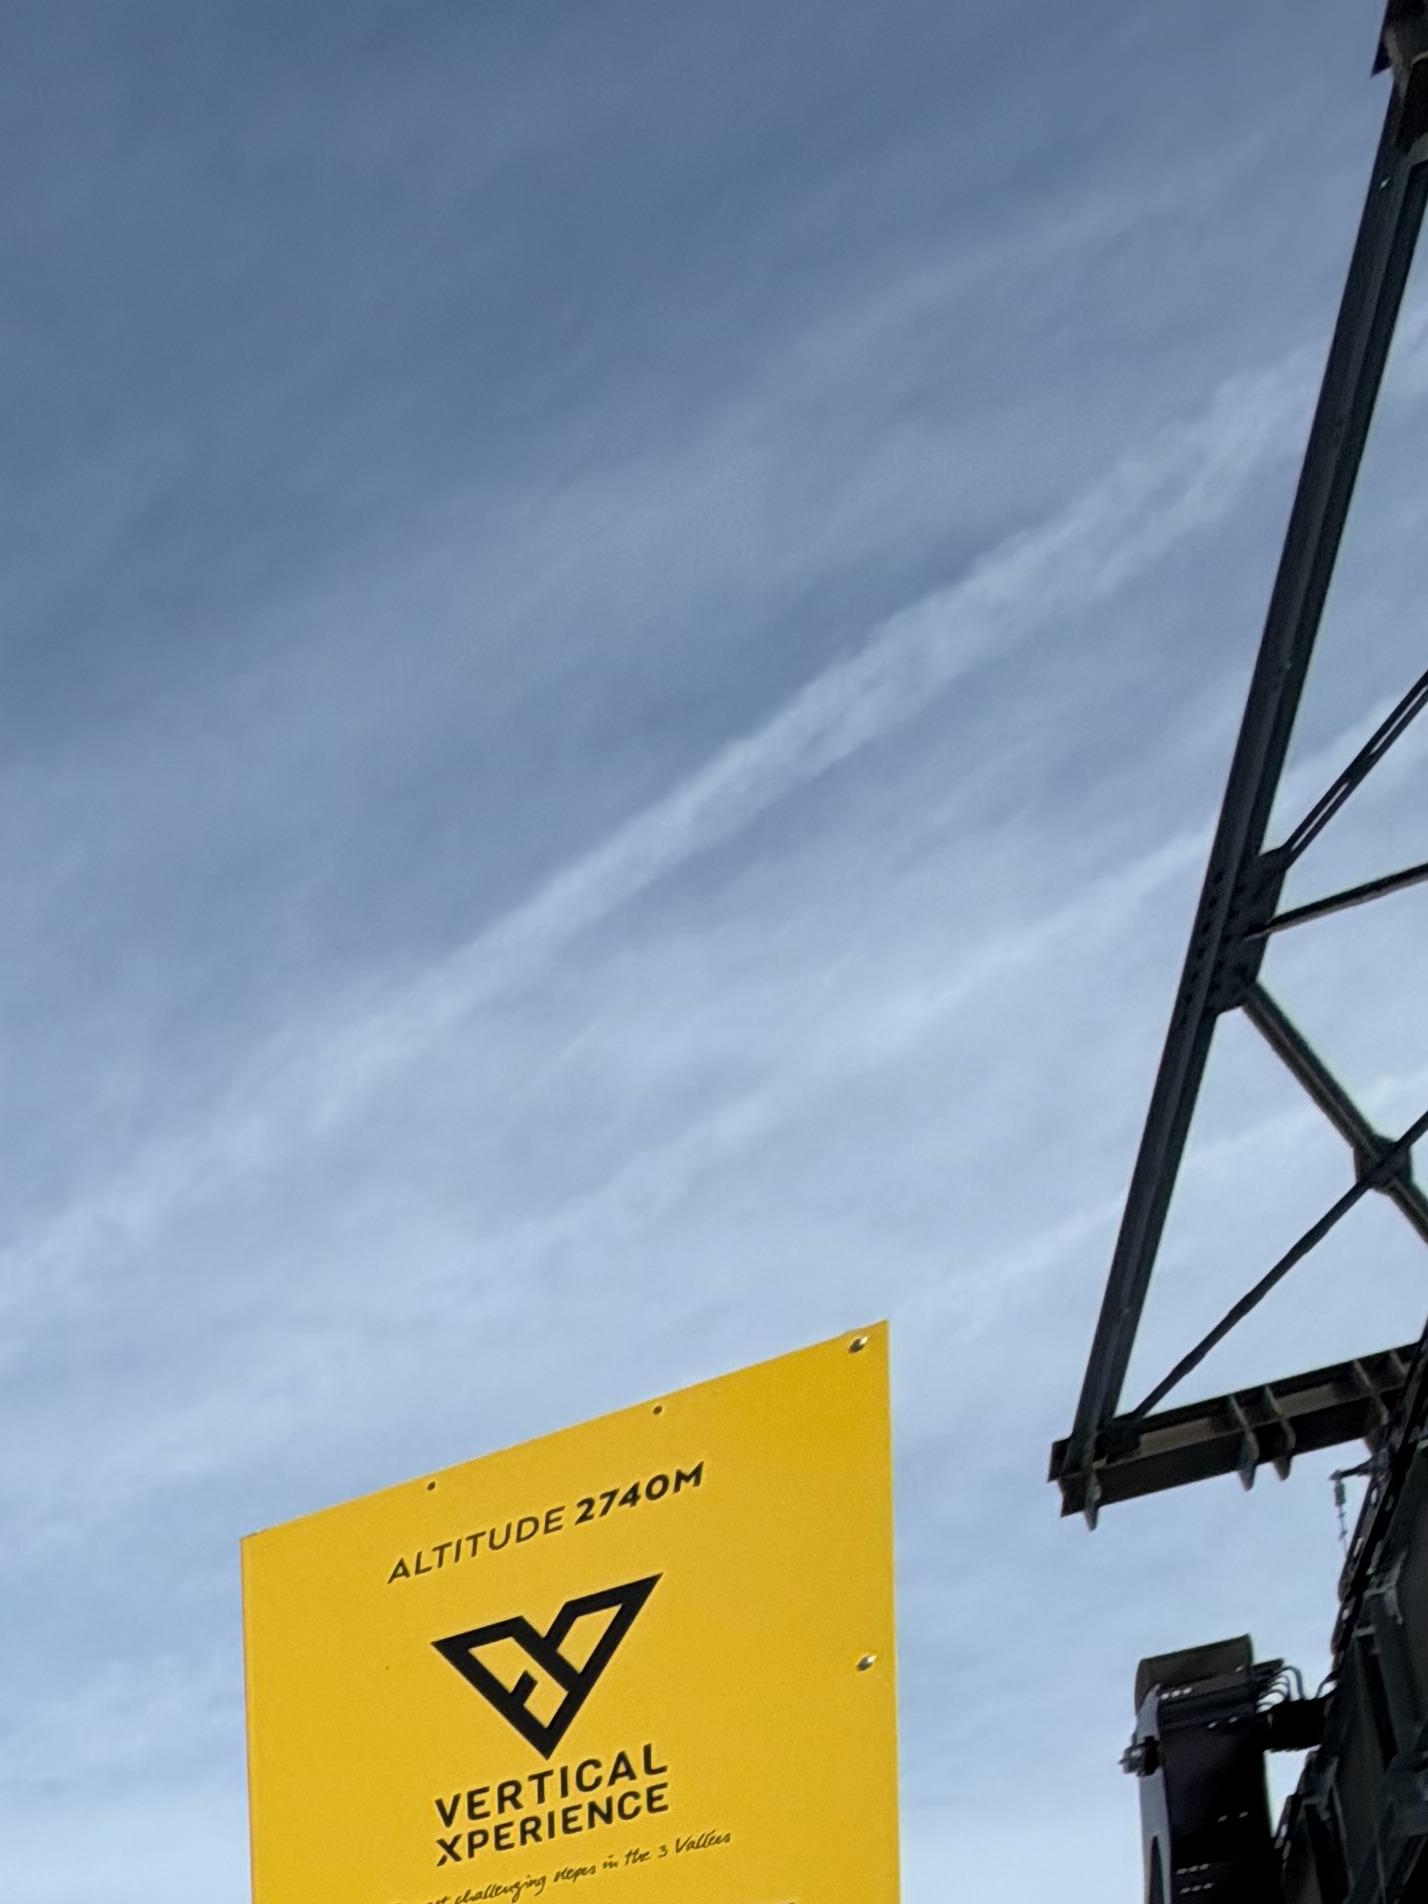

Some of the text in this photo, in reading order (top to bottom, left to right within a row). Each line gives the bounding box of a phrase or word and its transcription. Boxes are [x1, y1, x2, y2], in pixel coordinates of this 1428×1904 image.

[387, 1461, 704, 1584] ALTITUDE 2740M
[434, 1743, 668, 1828] VERTICAL
[436, 1782, 669, 1867] XPERIENCE
[454, 1874, 547, 1904] challenging
[602, 1854, 618, 1869] in
[624, 1847, 651, 1866] the
[657, 1844, 669, 1858] 3
[675, 1829, 731, 1854] Vallées
